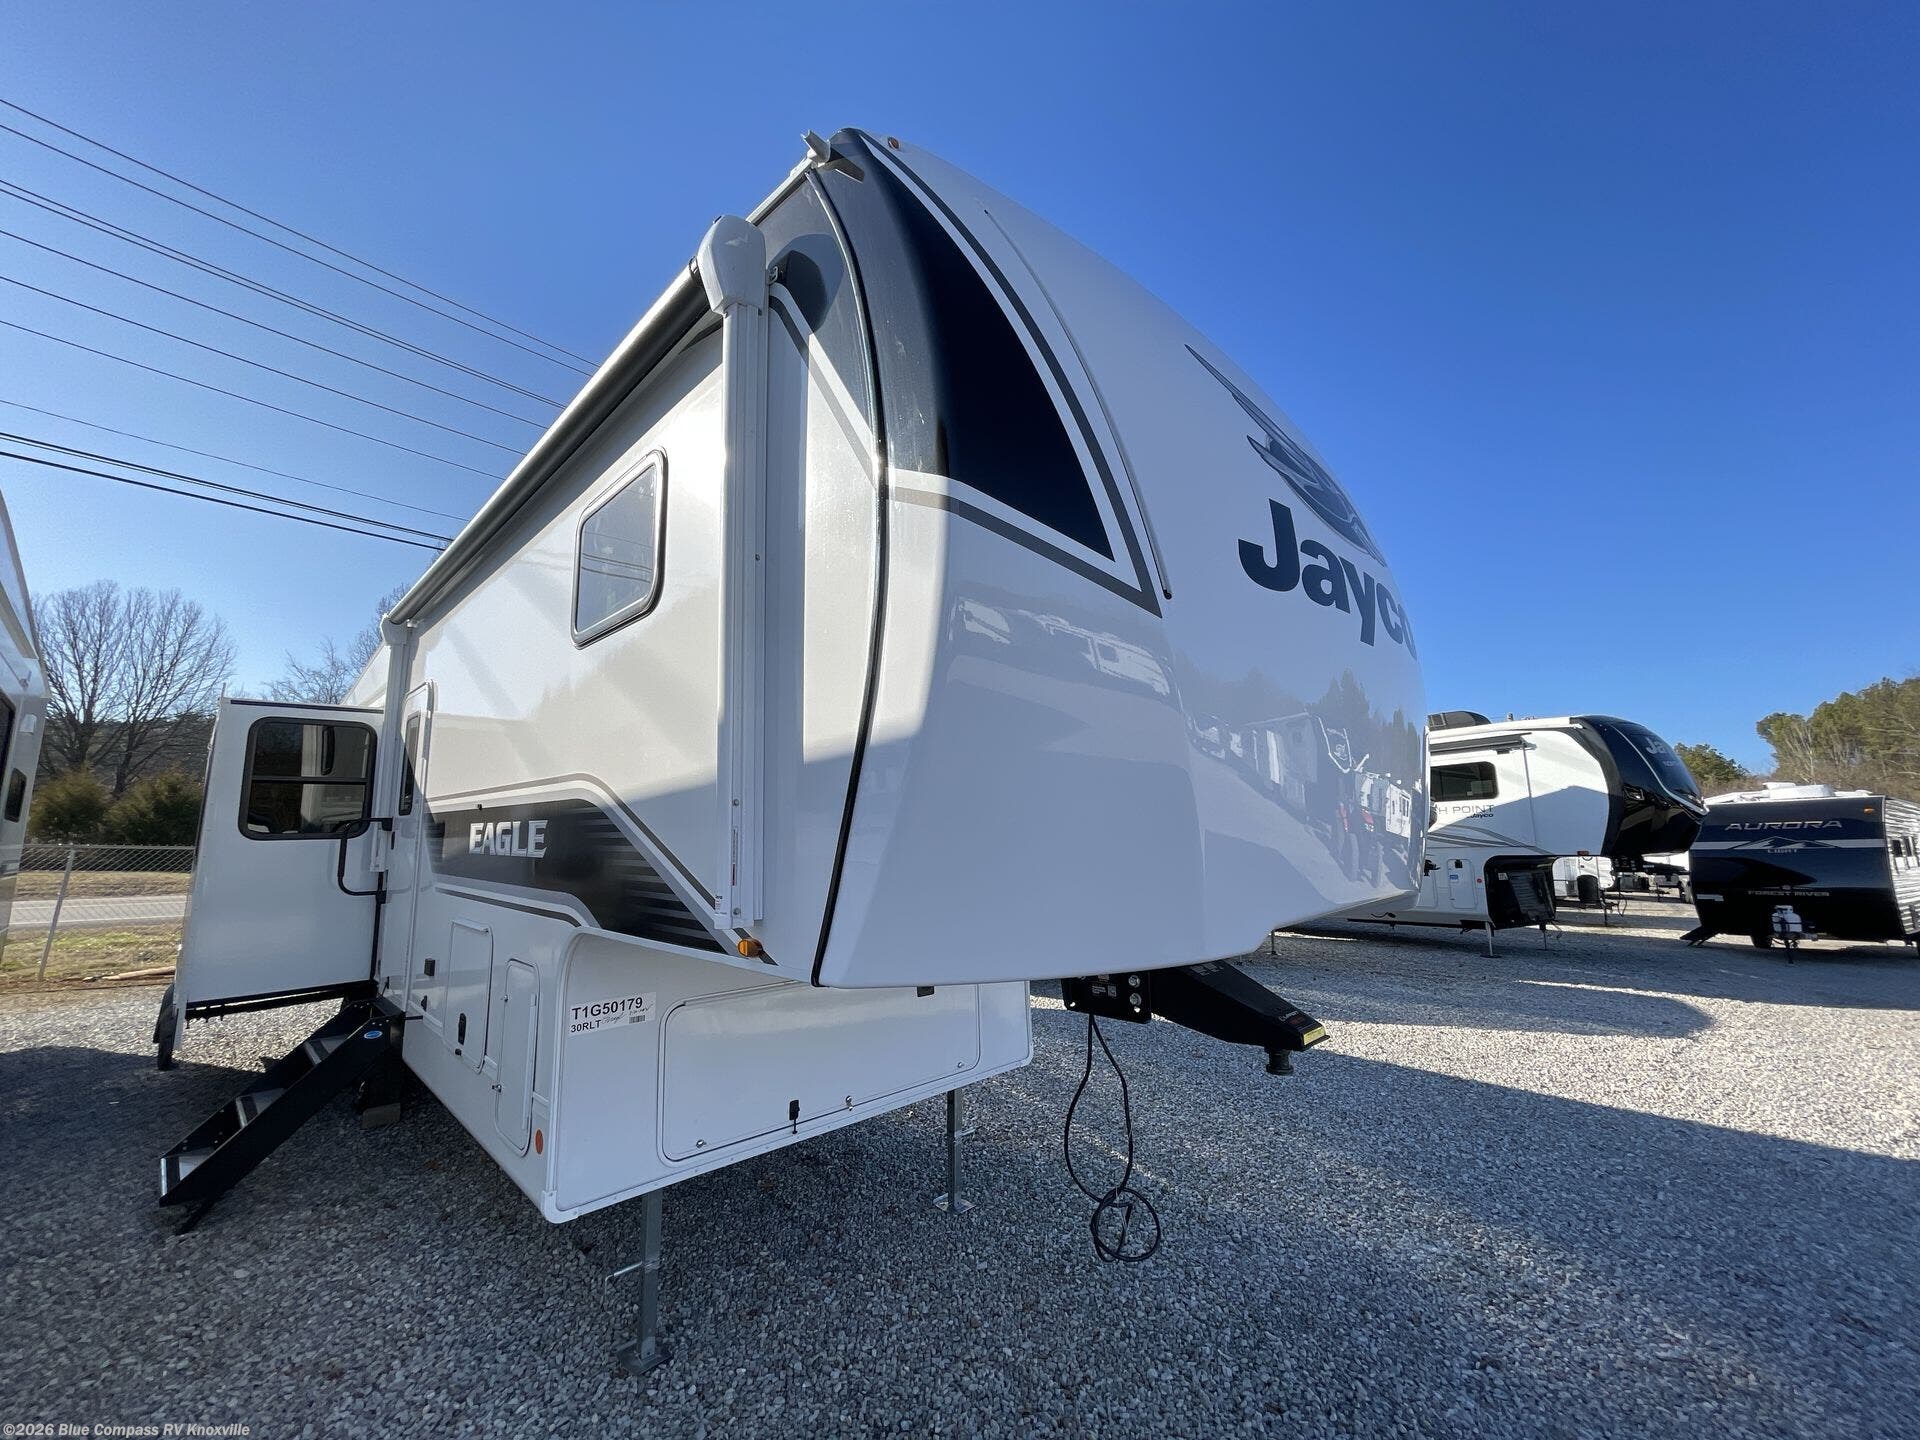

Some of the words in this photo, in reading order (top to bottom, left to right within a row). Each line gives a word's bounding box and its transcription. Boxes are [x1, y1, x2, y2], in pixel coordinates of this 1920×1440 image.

[1453, 804, 1494, 813] POINT
[1724, 820, 1843, 831] AURORA
[469, 820, 548, 858] EAGLE
[571, 997, 643, 1020] T1G50179
[570, 1019, 601, 1033] 30RLT
